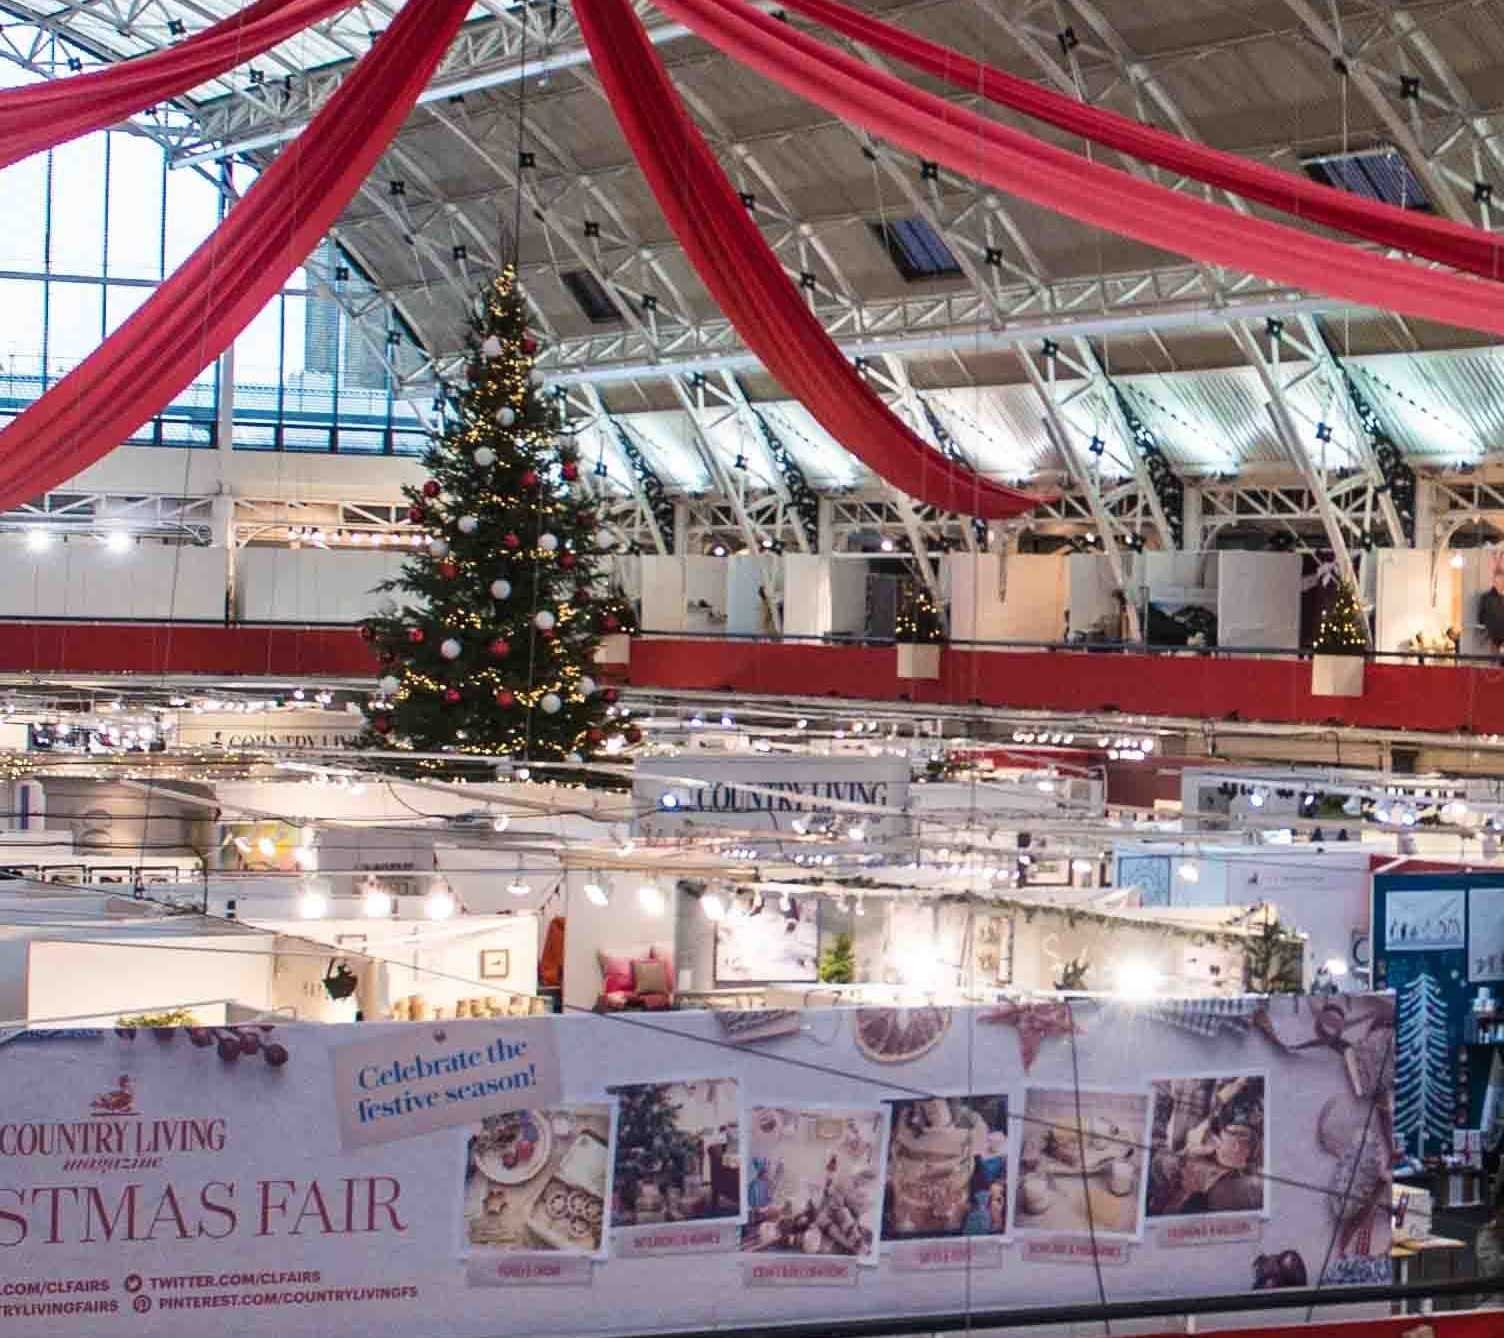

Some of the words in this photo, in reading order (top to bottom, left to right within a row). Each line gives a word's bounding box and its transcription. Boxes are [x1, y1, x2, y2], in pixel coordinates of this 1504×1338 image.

[358, 1051, 482, 1090] Celebrate
[486, 1038, 528, 1063] the
[356, 1090, 440, 1125] festive
[445, 1063, 537, 1102] season!
[134, 1118, 227, 1157] LIVING
[253, 1175, 409, 1238] FAIR
[149, 1268, 322, 1291] TWITTER.COM/CLFAIRS
